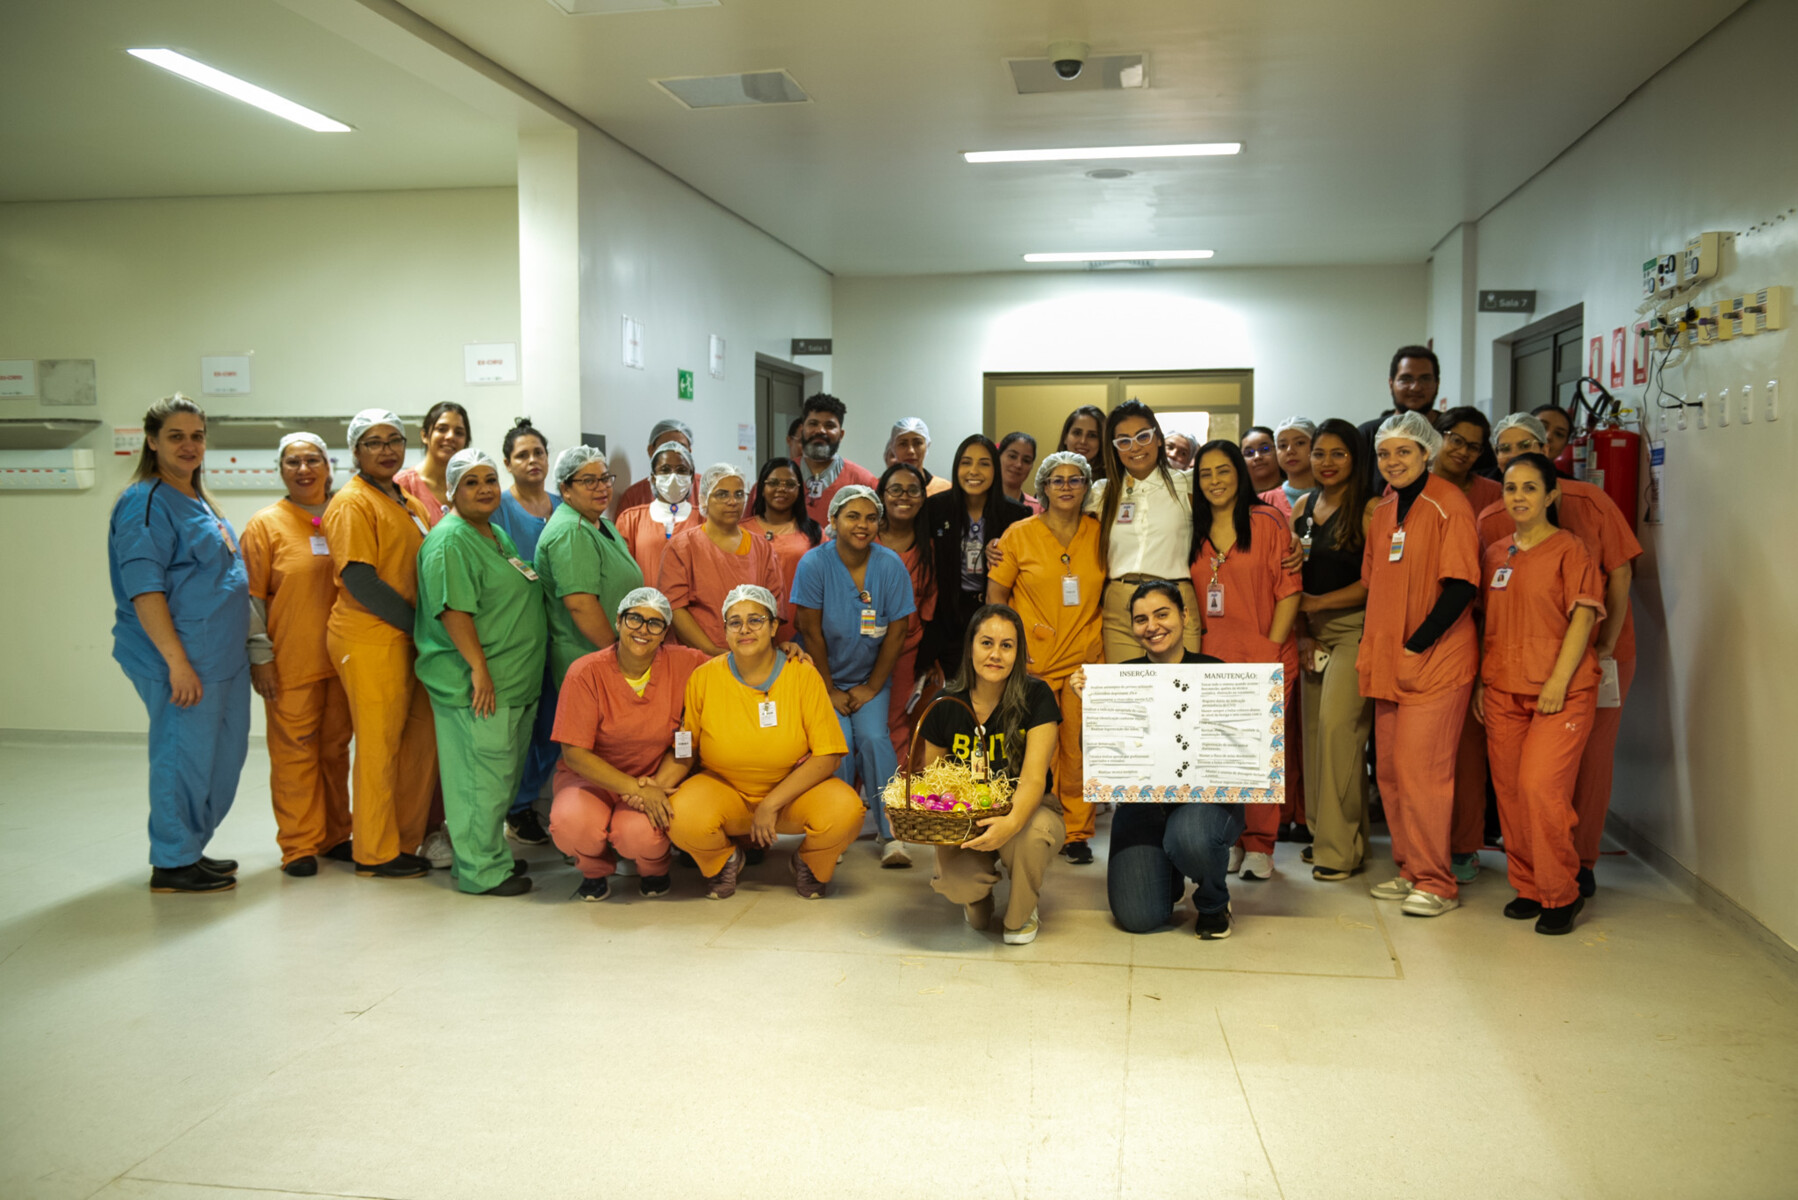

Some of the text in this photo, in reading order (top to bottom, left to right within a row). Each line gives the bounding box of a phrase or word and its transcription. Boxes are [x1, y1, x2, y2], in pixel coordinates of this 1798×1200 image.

[1499, 298, 1528, 307] Sala 7
[1119, 669, 1157, 678] INSERÇÃO:
[1204, 671, 1258, 680] MANUTENÇÃO:
